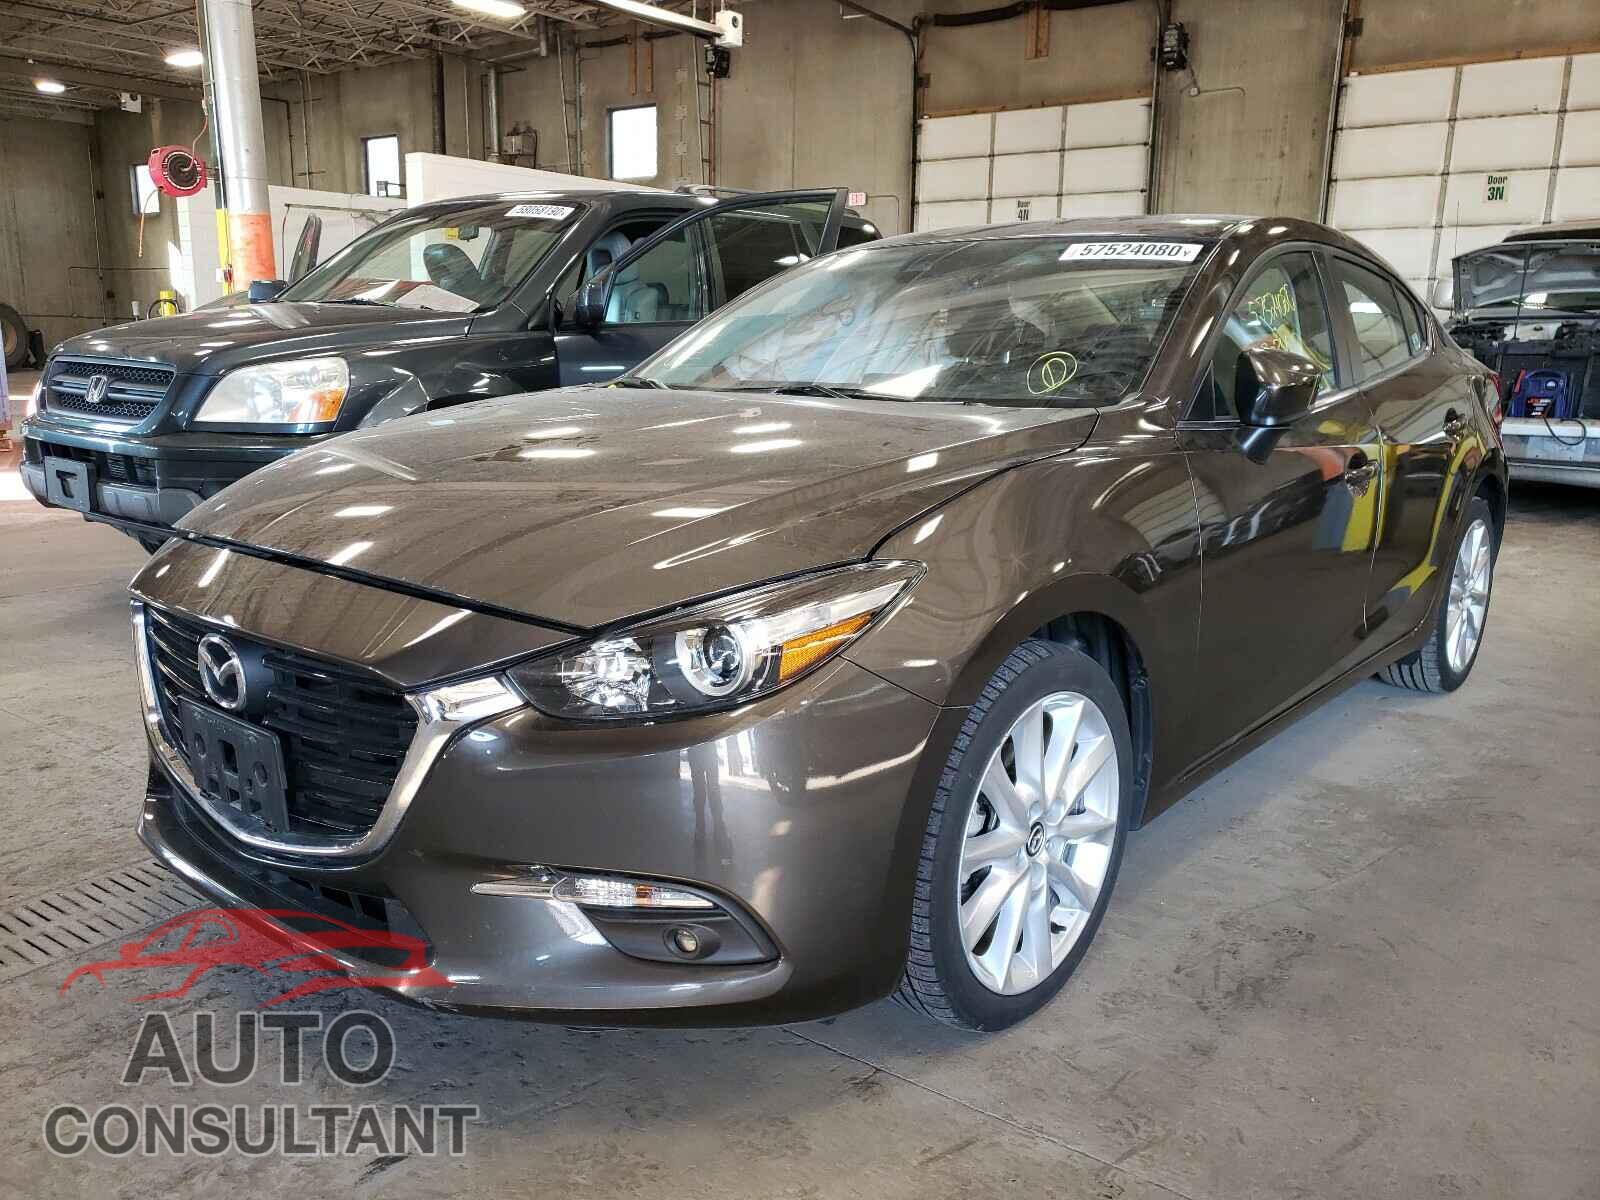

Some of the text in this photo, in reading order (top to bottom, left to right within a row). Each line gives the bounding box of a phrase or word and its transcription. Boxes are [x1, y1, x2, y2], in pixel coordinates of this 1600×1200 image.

[1487, 175, 1508, 185] Door
[1487, 186, 1505, 201] 3N
[1079, 243, 1182, 257] 57524080
